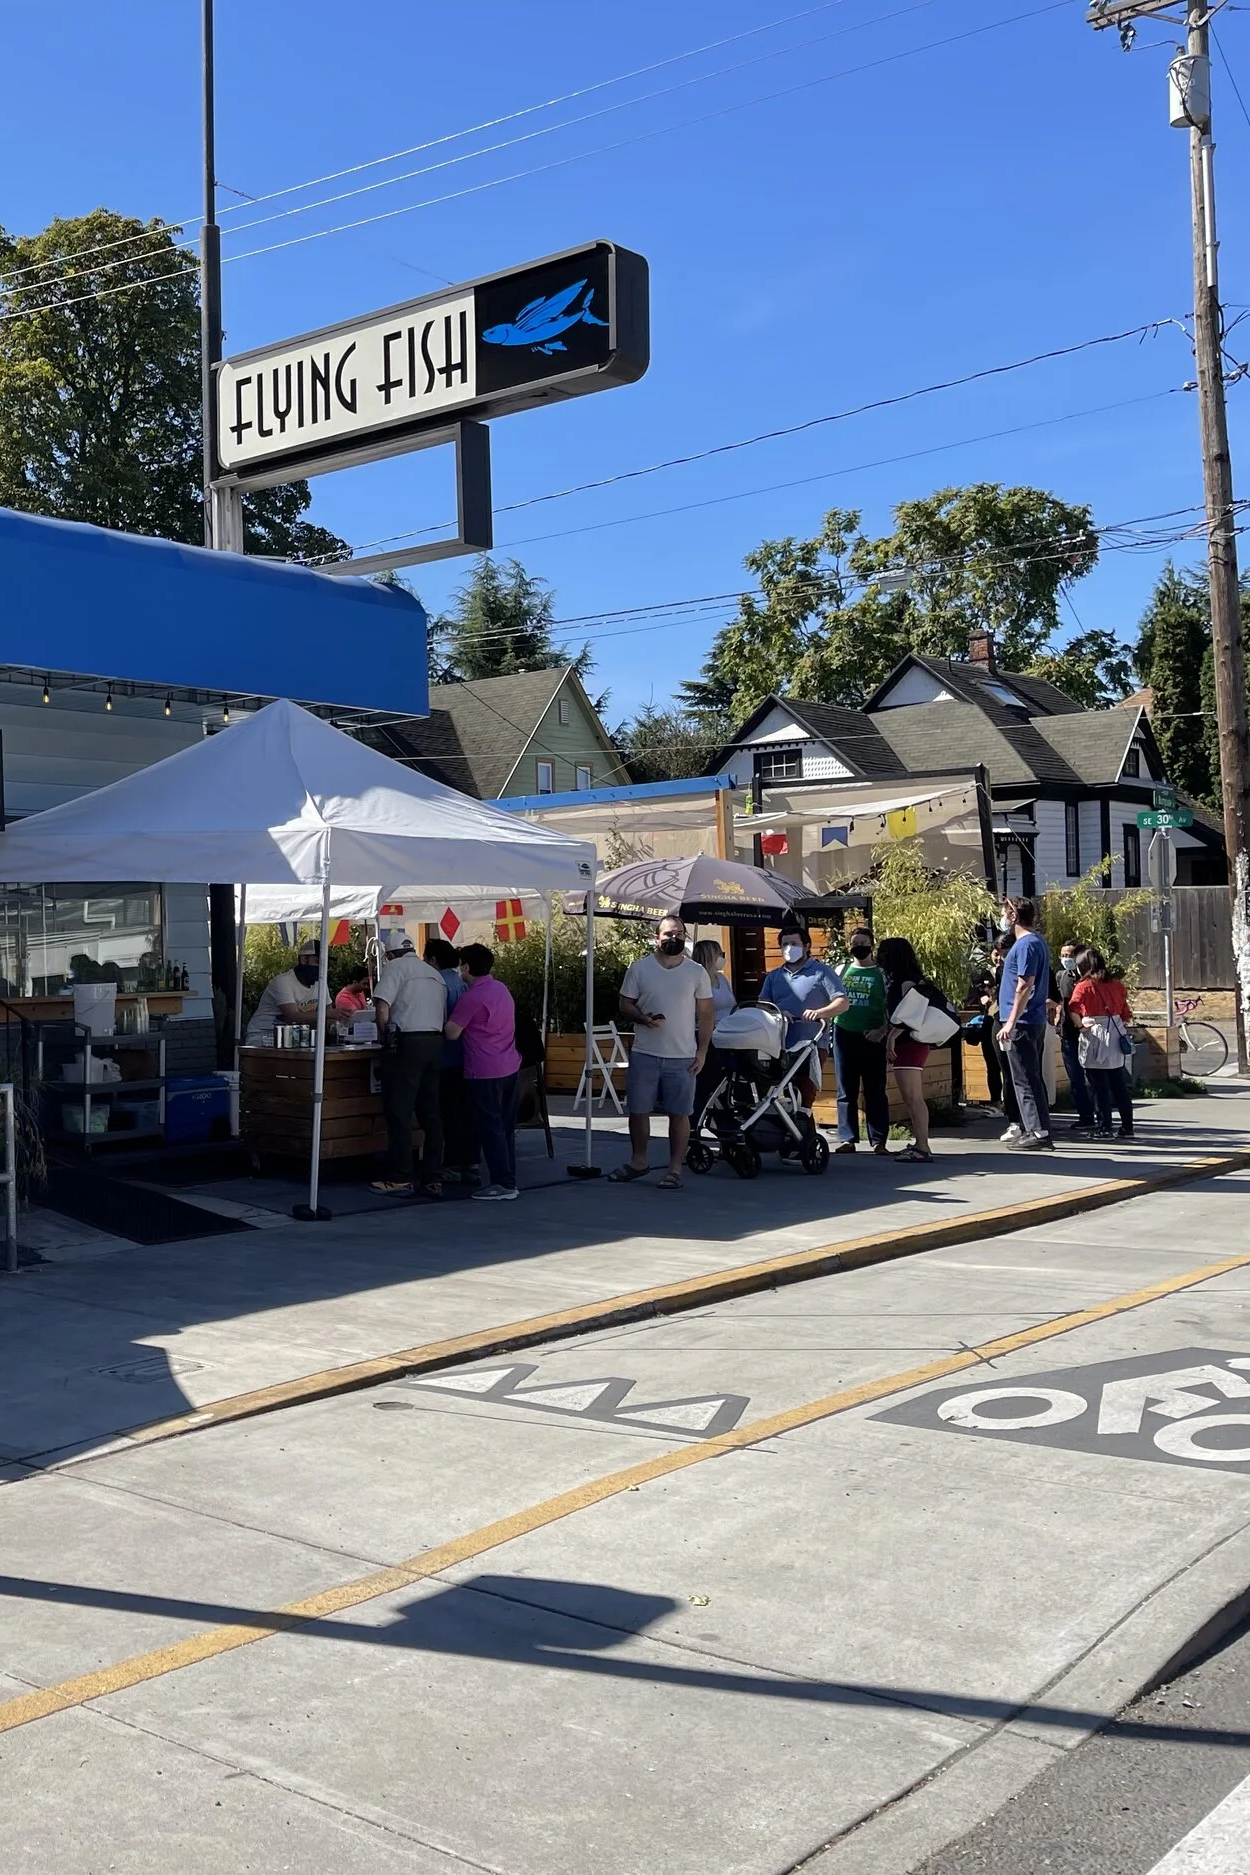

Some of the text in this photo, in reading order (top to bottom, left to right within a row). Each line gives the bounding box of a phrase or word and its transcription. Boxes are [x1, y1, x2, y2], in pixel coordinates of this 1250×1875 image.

[229, 310, 468, 445] FLYING FISH
[1143, 818, 1153, 826] SE
[701, 893, 737, 901] SINGHA
[610, 901, 669, 917] SINGHA BEER
